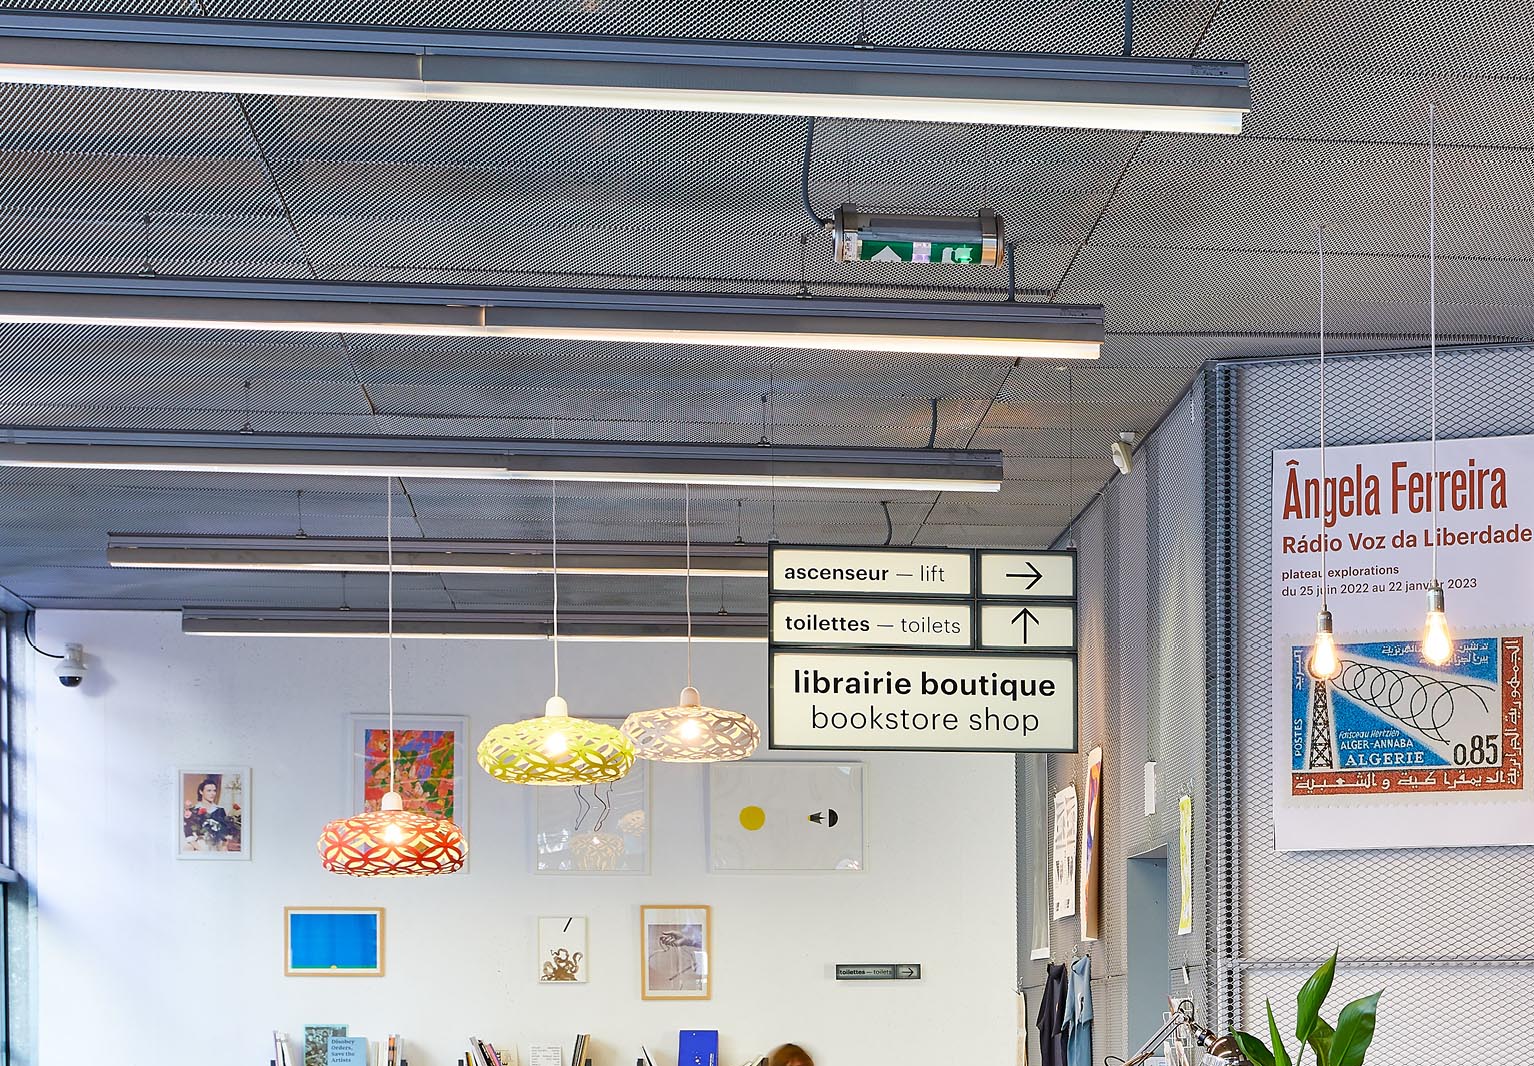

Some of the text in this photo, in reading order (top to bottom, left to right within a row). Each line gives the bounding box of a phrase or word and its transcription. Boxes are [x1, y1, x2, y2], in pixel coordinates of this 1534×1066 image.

[1283, 458, 1507, 528] Ângela Ferreira
[1283, 524, 1532, 554] Rádio Voz da Liberdade
[784, 566, 888, 581] ascenseur
[920, 565, 945, 582] lift
[1282, 565, 1399, 581] plateau explorations
[1282, 586, 1297, 596] du
[1300, 586, 1314, 596] 25
[1341, 583, 1369, 594] 2022
[1372, 583, 1385, 593] au
[1388, 581, 1402, 592] 22
[1448, 578, 1477, 589] 2023
[785, 615, 870, 632] toilettes
[901, 617, 961, 634] toilets
[794, 670, 1056, 701] librairie boutique
[812, 705, 1039, 736] bookstore shop
[1338, 730, 1369, 739] Faisceau
[1340, 739, 1414, 750] ALGER-ANNABA
[1345, 735, 1499, 766] ALGERIE 0,85
